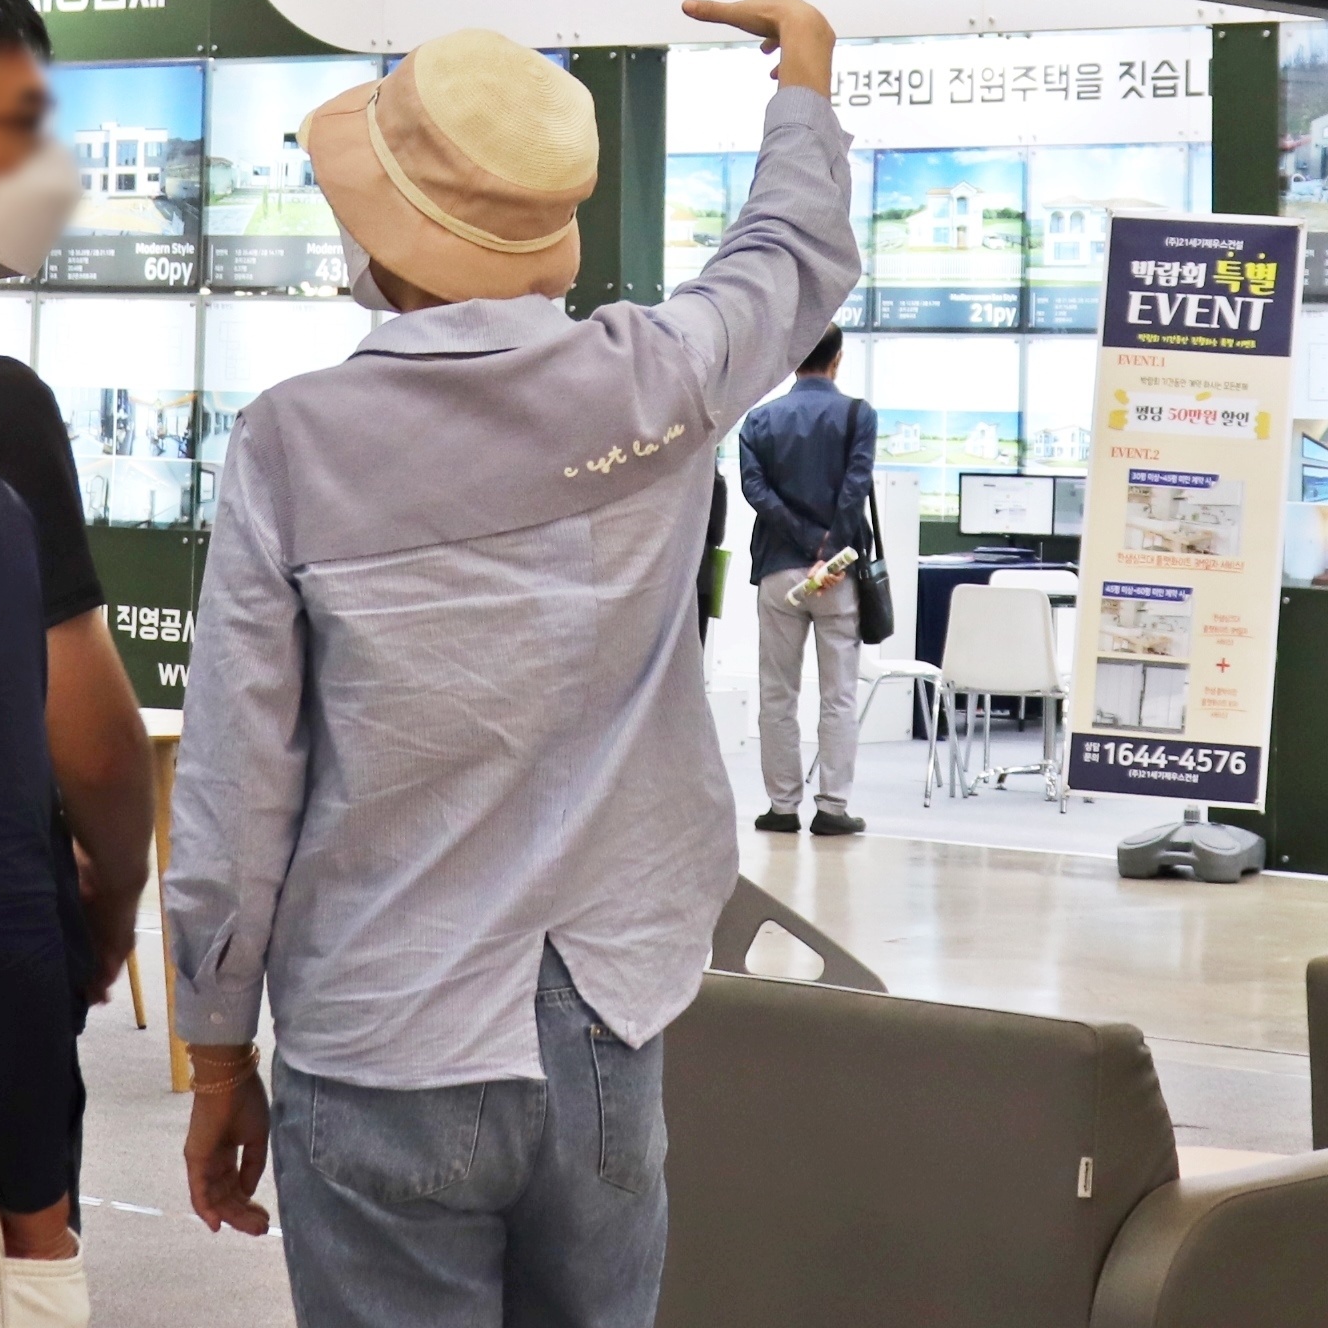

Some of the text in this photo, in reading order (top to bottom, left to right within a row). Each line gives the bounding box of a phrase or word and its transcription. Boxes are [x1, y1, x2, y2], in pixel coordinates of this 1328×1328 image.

[948, 62, 1104, 105] 전원주택을
[135, 242, 195, 256] Modern Style
[1165, 236, 1244, 251] (주)21세기제우스건설
[144, 257, 194, 286] 60py
[1131, 259, 1208, 289] 박람회
[1213, 255, 1278, 296] 특별
[970, 303, 1017, 327] 21py
[1127, 290, 1274, 332] EVENT
[1117, 354, 1165, 367] EVENT.1
[1168, 407, 1219, 425] 50만원
[1222, 410, 1250, 427] 할인
[1110, 446, 1160, 461] EVENT.2
[1084, 741, 1100, 752] 상담
[1083, 752, 1099, 763] 문의
[1103, 741, 1247, 775] 1644-4576
